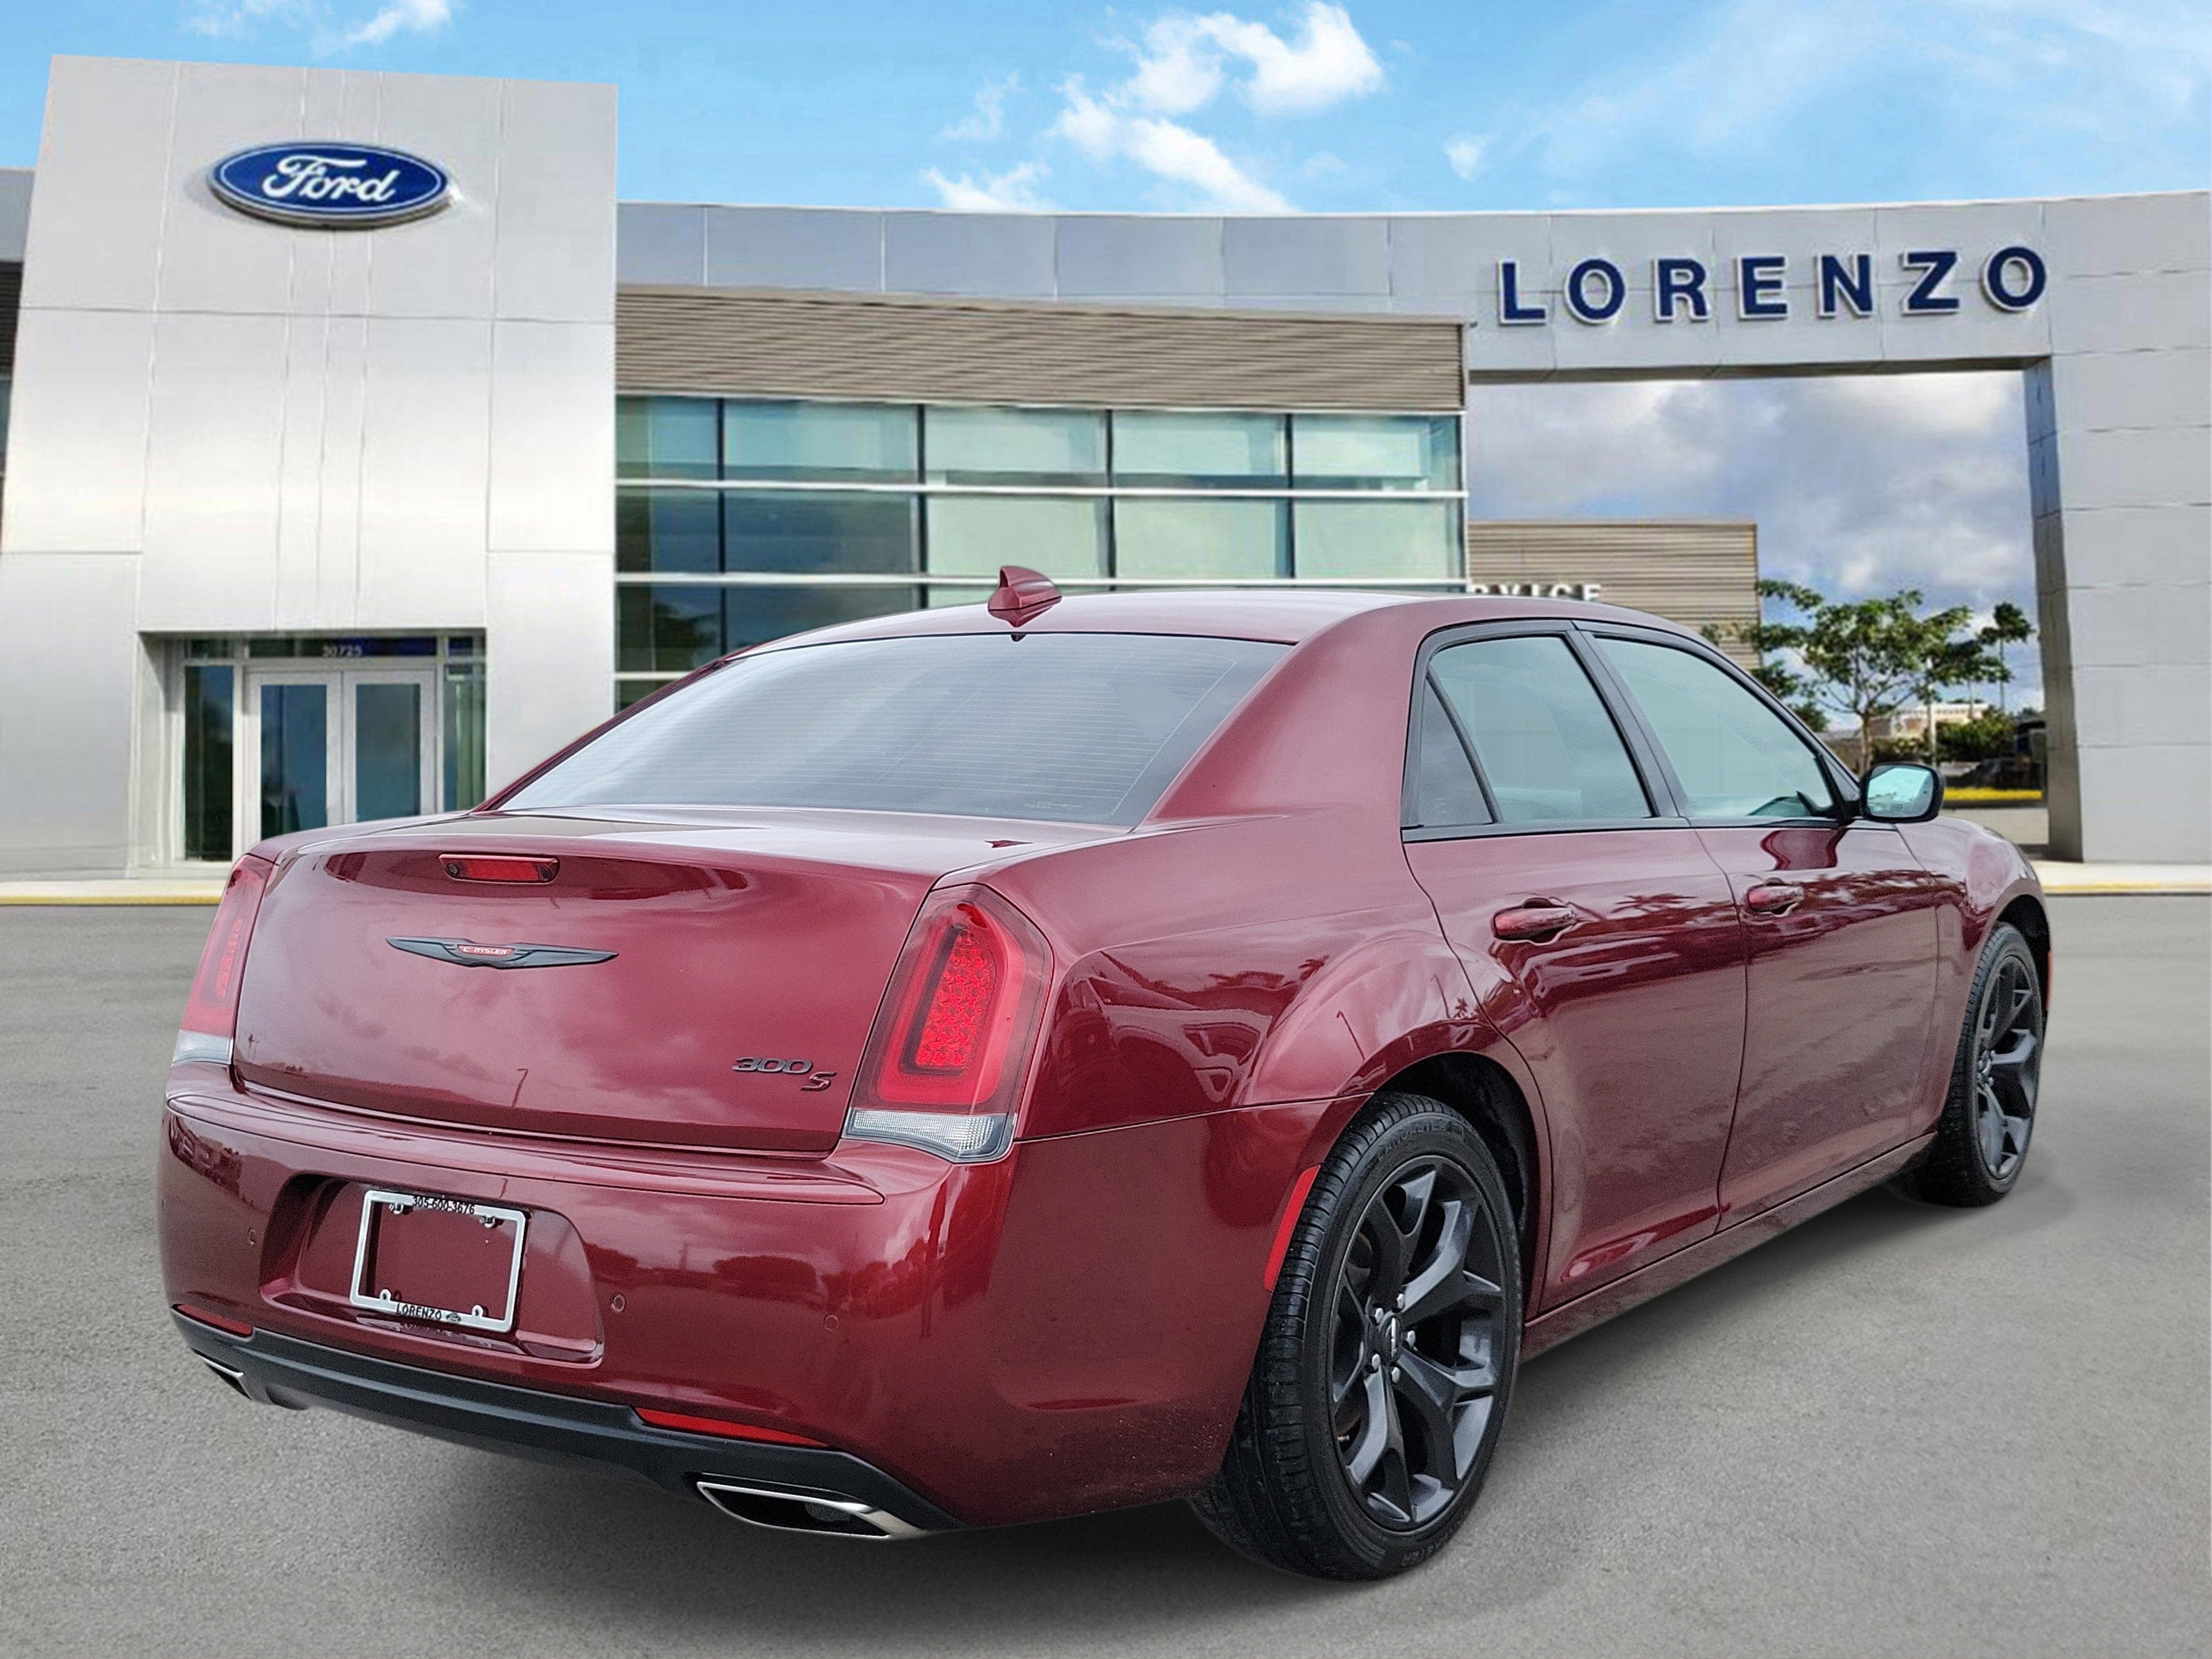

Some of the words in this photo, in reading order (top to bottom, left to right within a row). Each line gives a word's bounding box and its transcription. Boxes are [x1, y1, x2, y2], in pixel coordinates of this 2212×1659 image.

[262, 154, 400, 201] Ford
[1497, 246, 2047, 326] LORENZO
[462, 946, 508, 956] CRYSLER
[412, 1195, 475, 1215] 305-600-3676
[396, 1302, 443, 1321] LORENZO
